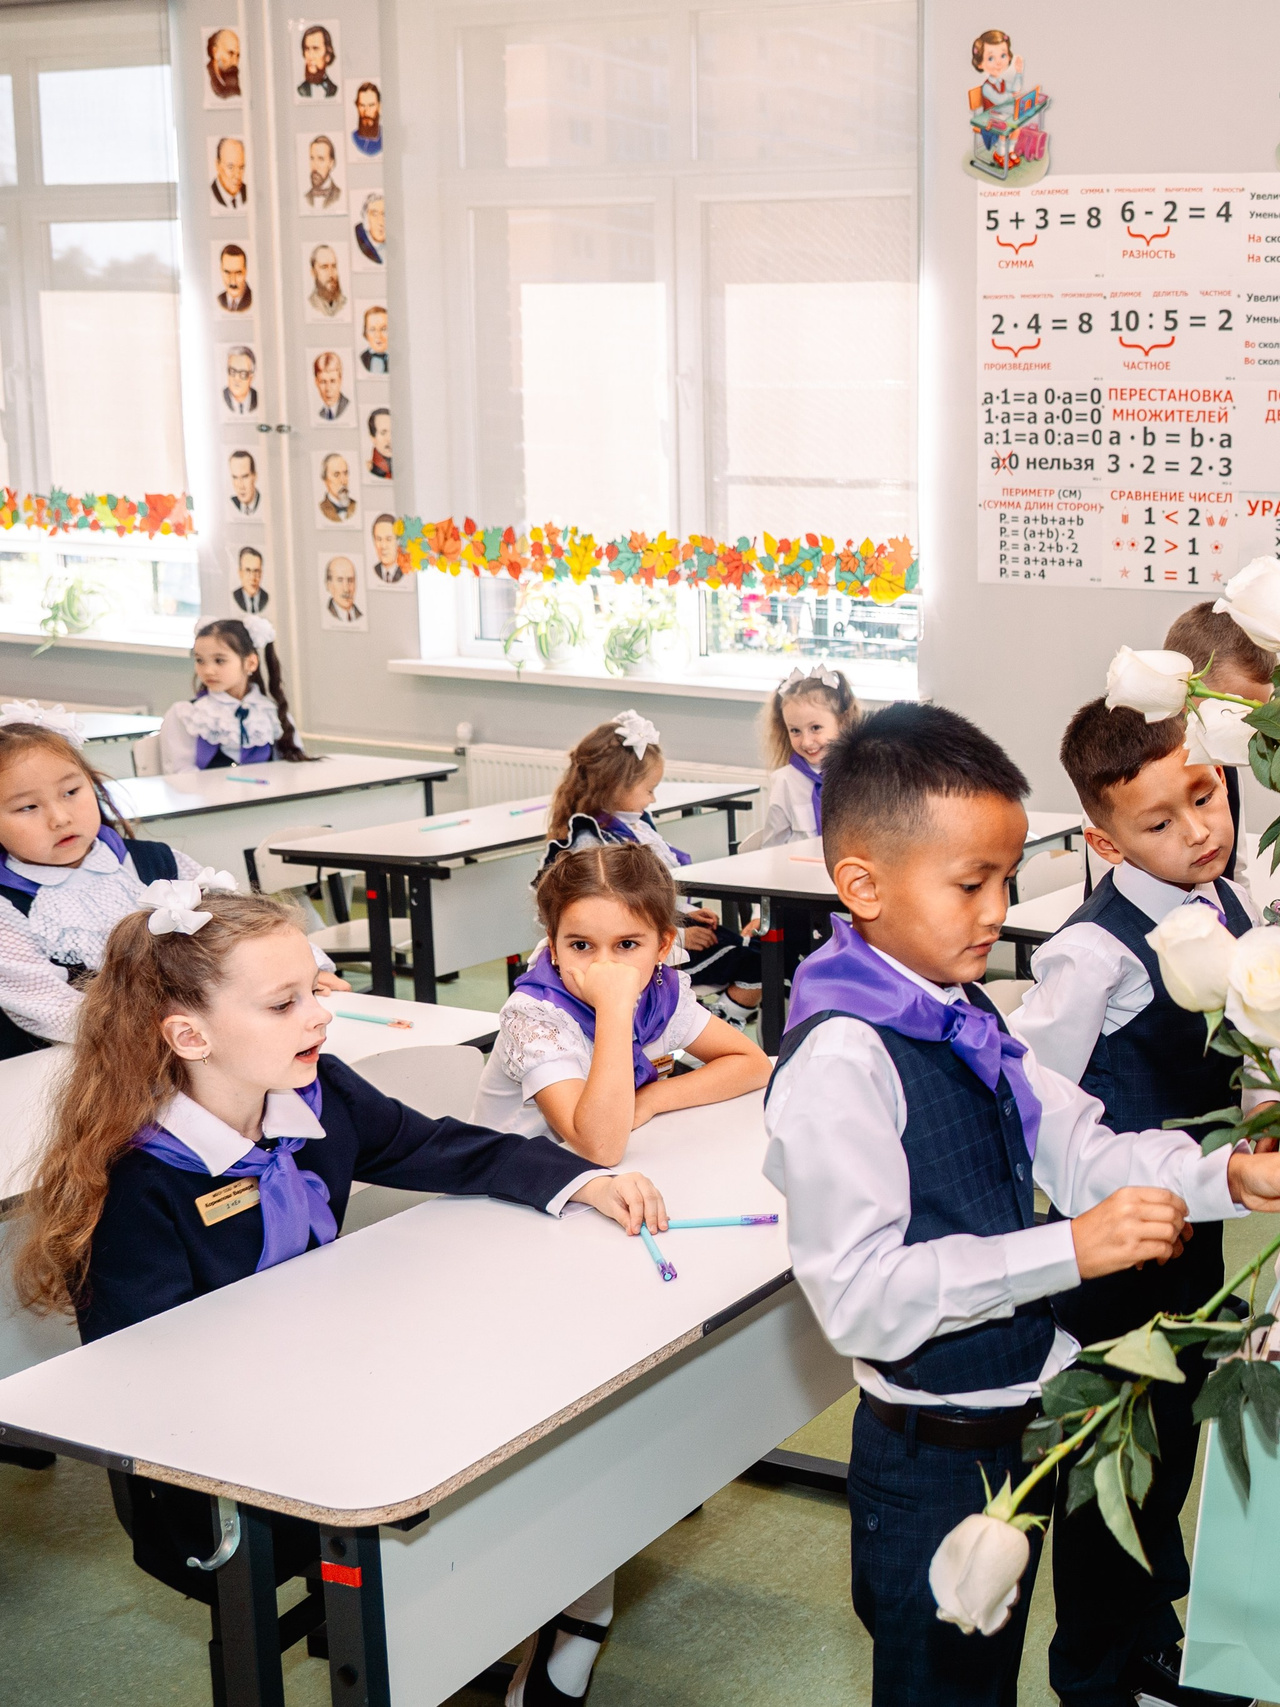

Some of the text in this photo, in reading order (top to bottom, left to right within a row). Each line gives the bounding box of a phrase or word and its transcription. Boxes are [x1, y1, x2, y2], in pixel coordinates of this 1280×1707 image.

[986, 209, 999, 231] 5
[1035, 208, 1049, 229] 3
[1087, 207, 1101, 228] 8
[1121, 201, 1135, 223] 6
[1164, 201, 1178, 222] 2
[1216, 201, 1232, 222] 4
[1248, 234, 1261, 243] На
[1122, 250, 1175, 259] РАЗНОСТЬ
[1248, 254, 1261, 263] На
[998, 260, 1034, 269] СУММА
[992, 314, 1004, 334] 2
[1027, 313, 1041, 334] 4
[1078, 313, 1092, 334] 8
[1111, 310, 1139, 331] 10
[1164, 310, 1178, 331] 5
[1218, 309, 1233, 331] 2
[984, 363, 1052, 371] ПРОИЗВЕДЕНИЕ
[1124, 361, 1170, 370] ЧАСТНОЕ
[1109, 388, 1234, 403] ПЕРЕСТАНОВКА
[1113, 406, 1228, 423] МНОЖИТЕЛЕЙ
[1026, 457, 1094, 471] нельзя
[1108, 454, 1120, 473] 3
[1143, 455, 1155, 474] 2
[1002, 488, 1082, 500] ПЕРИМЕТР (СМ)
[1111, 490, 1232, 503] СРАВНЕНИЕ ЧИСЕЛ
[983, 500, 1102, 513] (СУММА ДЛИН СТОРОН)
[1145, 507, 1155, 525] 1
[1188, 508, 1200, 526] 2
[1144, 536, 1156, 554] 2
[1188, 538, 1199, 555] 1
[1144, 565, 1155, 582] 1
[1188, 567, 1199, 584] 1
